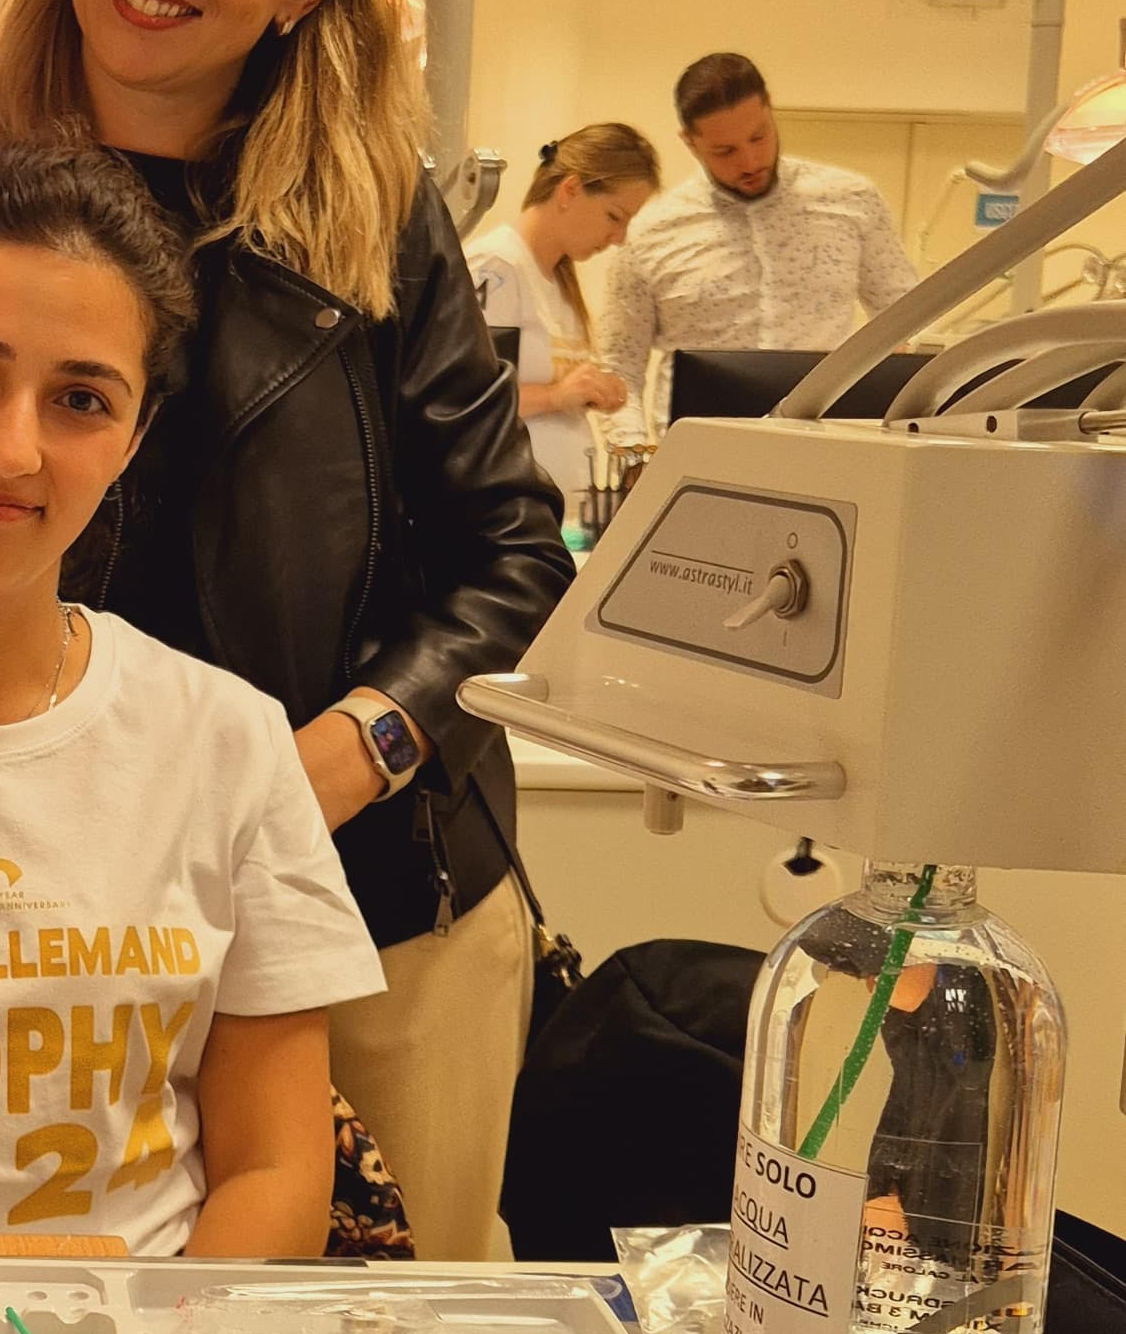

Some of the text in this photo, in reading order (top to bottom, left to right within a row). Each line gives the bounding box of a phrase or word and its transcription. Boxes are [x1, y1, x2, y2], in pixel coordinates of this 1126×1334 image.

[649, 560, 753, 595] www.astrastyl.it
[755, 1152, 817, 1200] SOLO
[730, 1229, 829, 1312] ALIZZATA
[749, 1300, 764, 1325] IN
